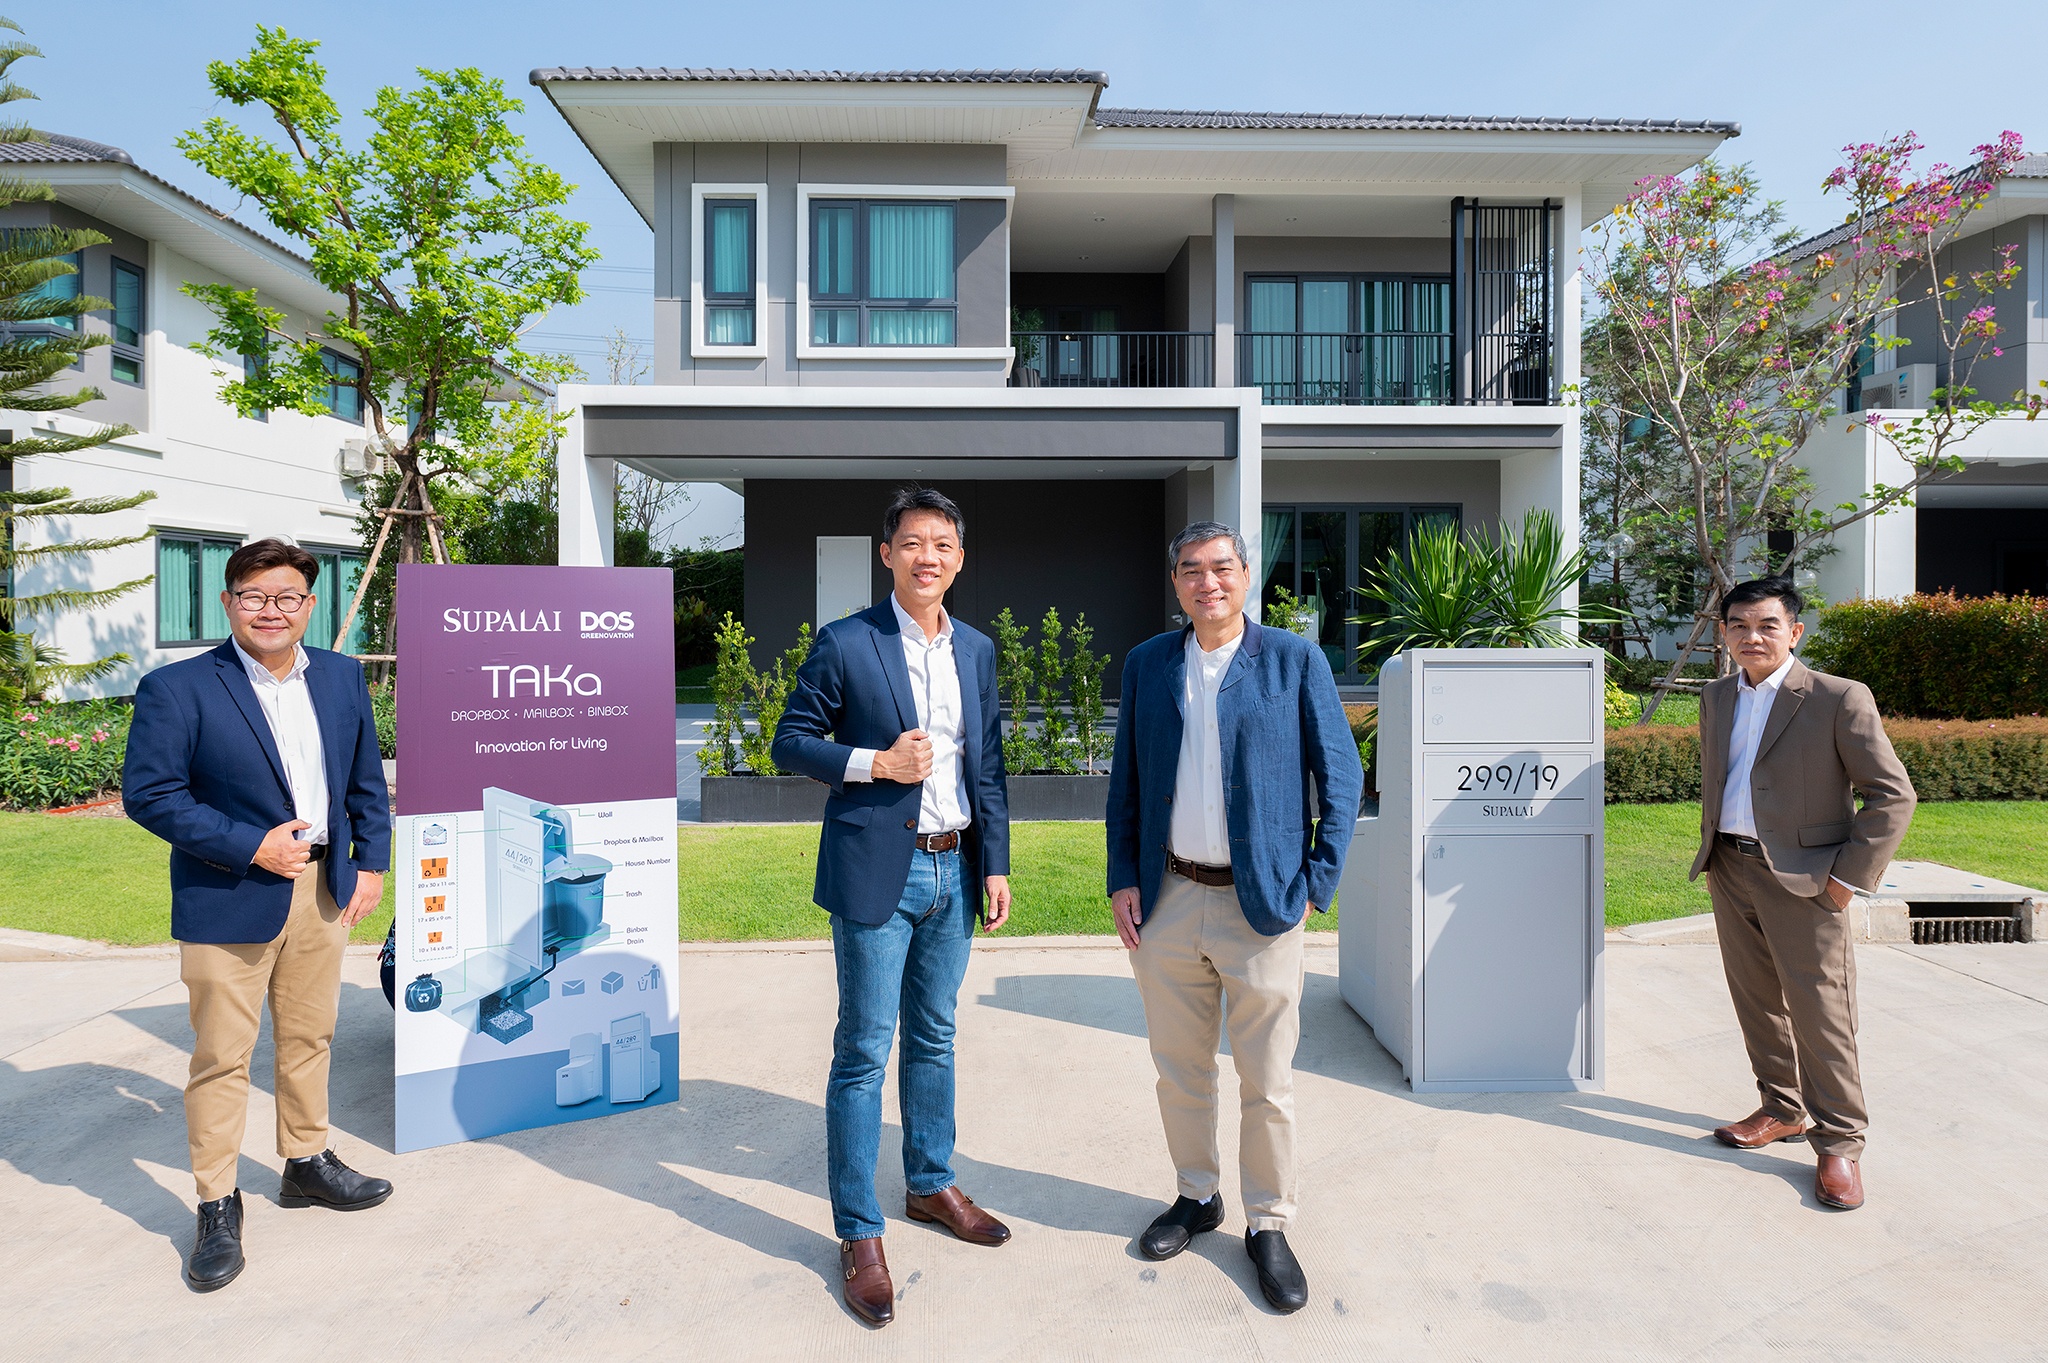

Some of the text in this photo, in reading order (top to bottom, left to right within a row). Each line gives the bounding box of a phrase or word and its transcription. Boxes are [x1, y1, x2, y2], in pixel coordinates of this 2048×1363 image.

[443, 607, 562, 633] SUPALAI
[580, 611, 635, 632] DOS
[451, 705, 629, 722] DROPBOX MAILBOX BINBOX
[475, 736, 608, 754] Innovation for Living
[1457, 762, 1559, 795] 299/19
[1482, 804, 1534, 817] SUPALAI
[603, 838, 631, 846] Dropbox
[505, 849, 534, 867] 44/289
[625, 890, 643, 898] Trash
[626, 926, 649, 934] Binbox
